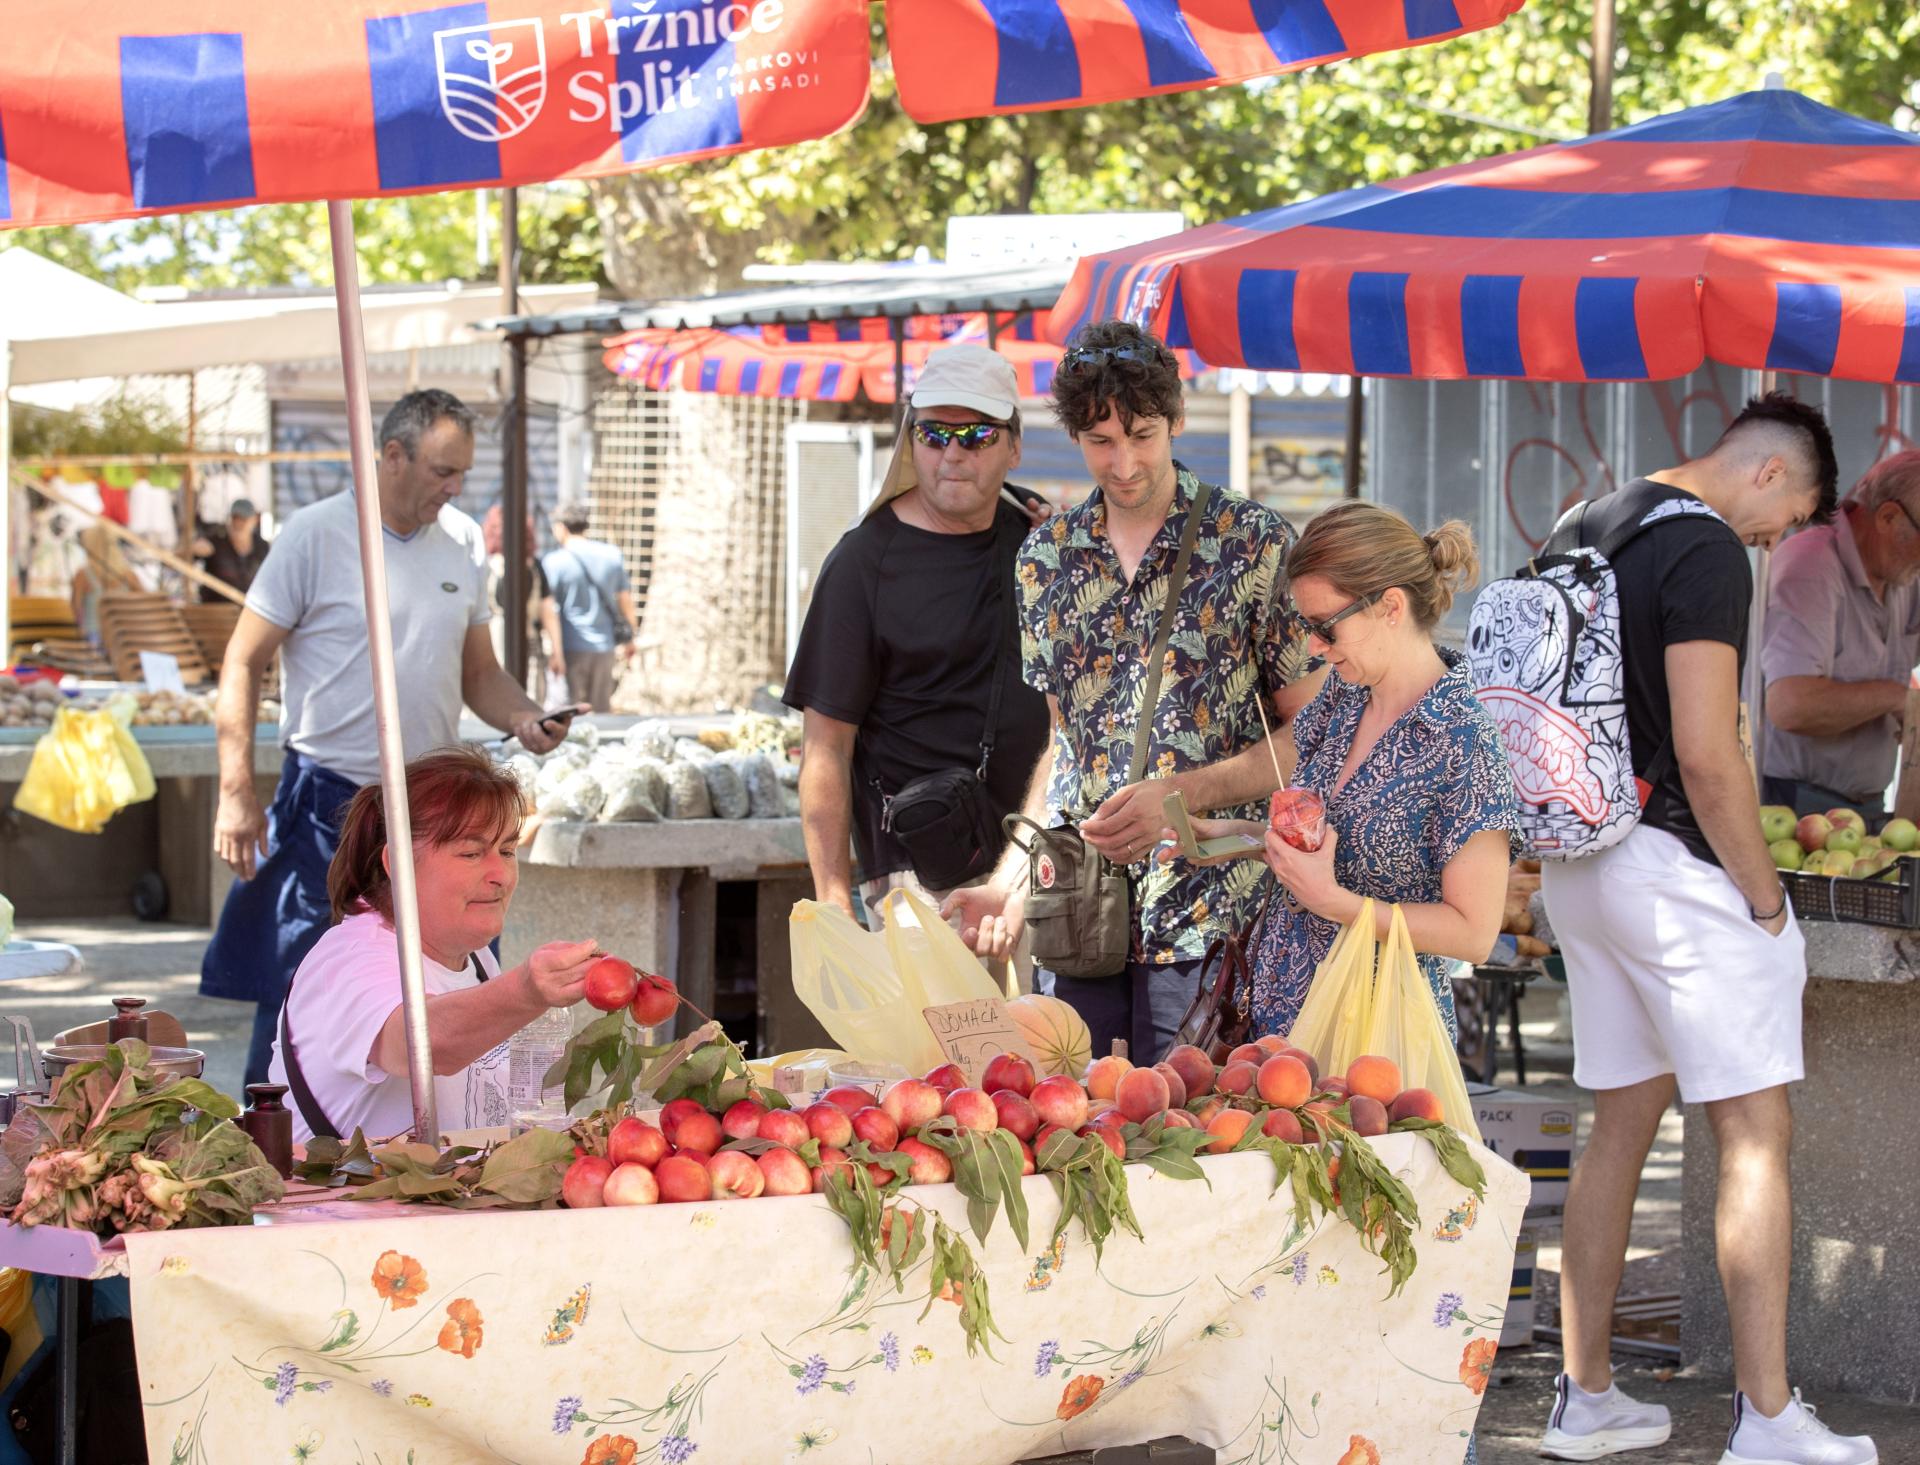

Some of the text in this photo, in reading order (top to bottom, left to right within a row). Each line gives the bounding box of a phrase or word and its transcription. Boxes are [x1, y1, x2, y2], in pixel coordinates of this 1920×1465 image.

[560, 0, 784, 58] Tržnice
[716, 50, 818, 81] PARKOVI
[567, 60, 702, 133] Split
[716, 73, 820, 100] I NASADI
[1480, 1110, 1513, 1122] PACK
